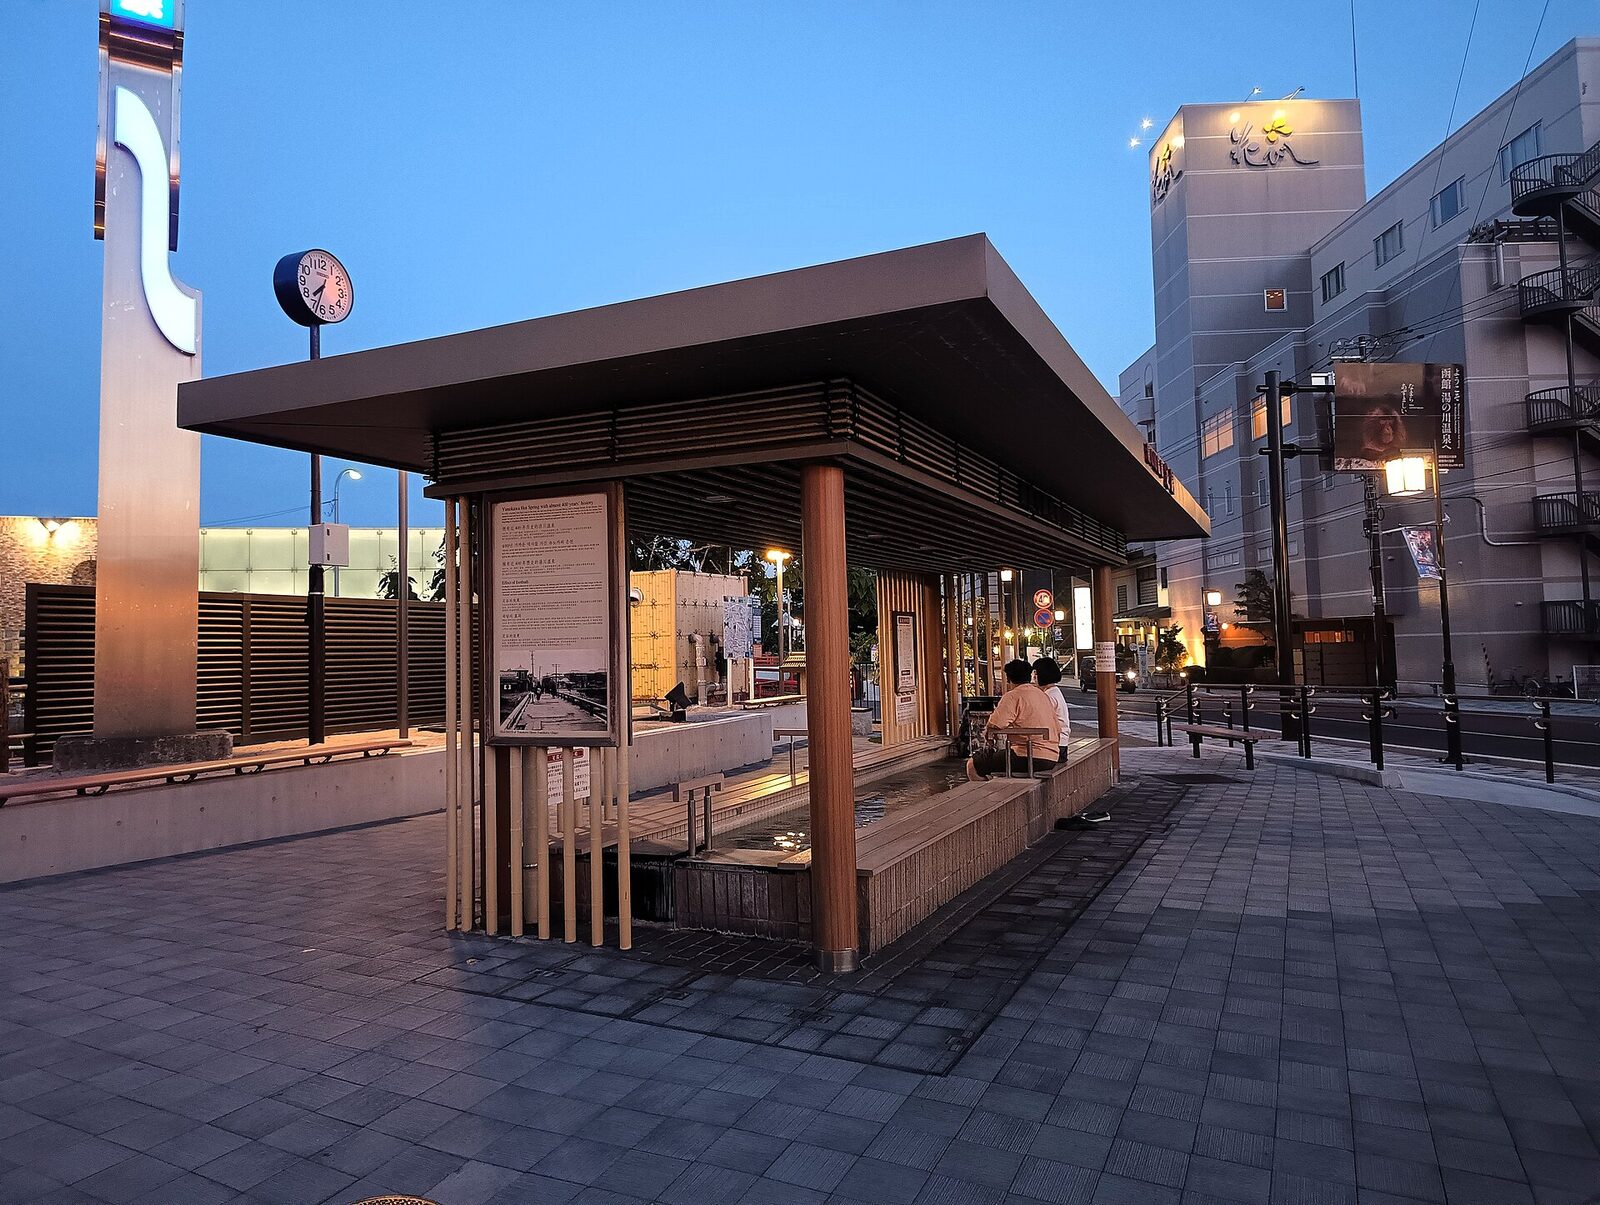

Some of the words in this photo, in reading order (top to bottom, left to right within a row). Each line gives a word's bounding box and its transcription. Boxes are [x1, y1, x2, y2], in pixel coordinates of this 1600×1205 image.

[300, 263, 311, 276] 10
[318, 259, 327, 271] 12
[299, 275, 306, 286] 9
[335, 275, 341, 286] 2
[304, 287, 310, 298] 8
[338, 288, 344, 299] 3
[311, 298, 317, 309] 7
[335, 299, 341, 309] 4
[320, 304, 326, 315] 6
[329, 304, 335, 315] 5
[1441, 367, 1451, 391] 函館
[1453, 368, 1461, 402] ようこそ
[1441, 392, 1452, 450] 湯の川温泉へ
